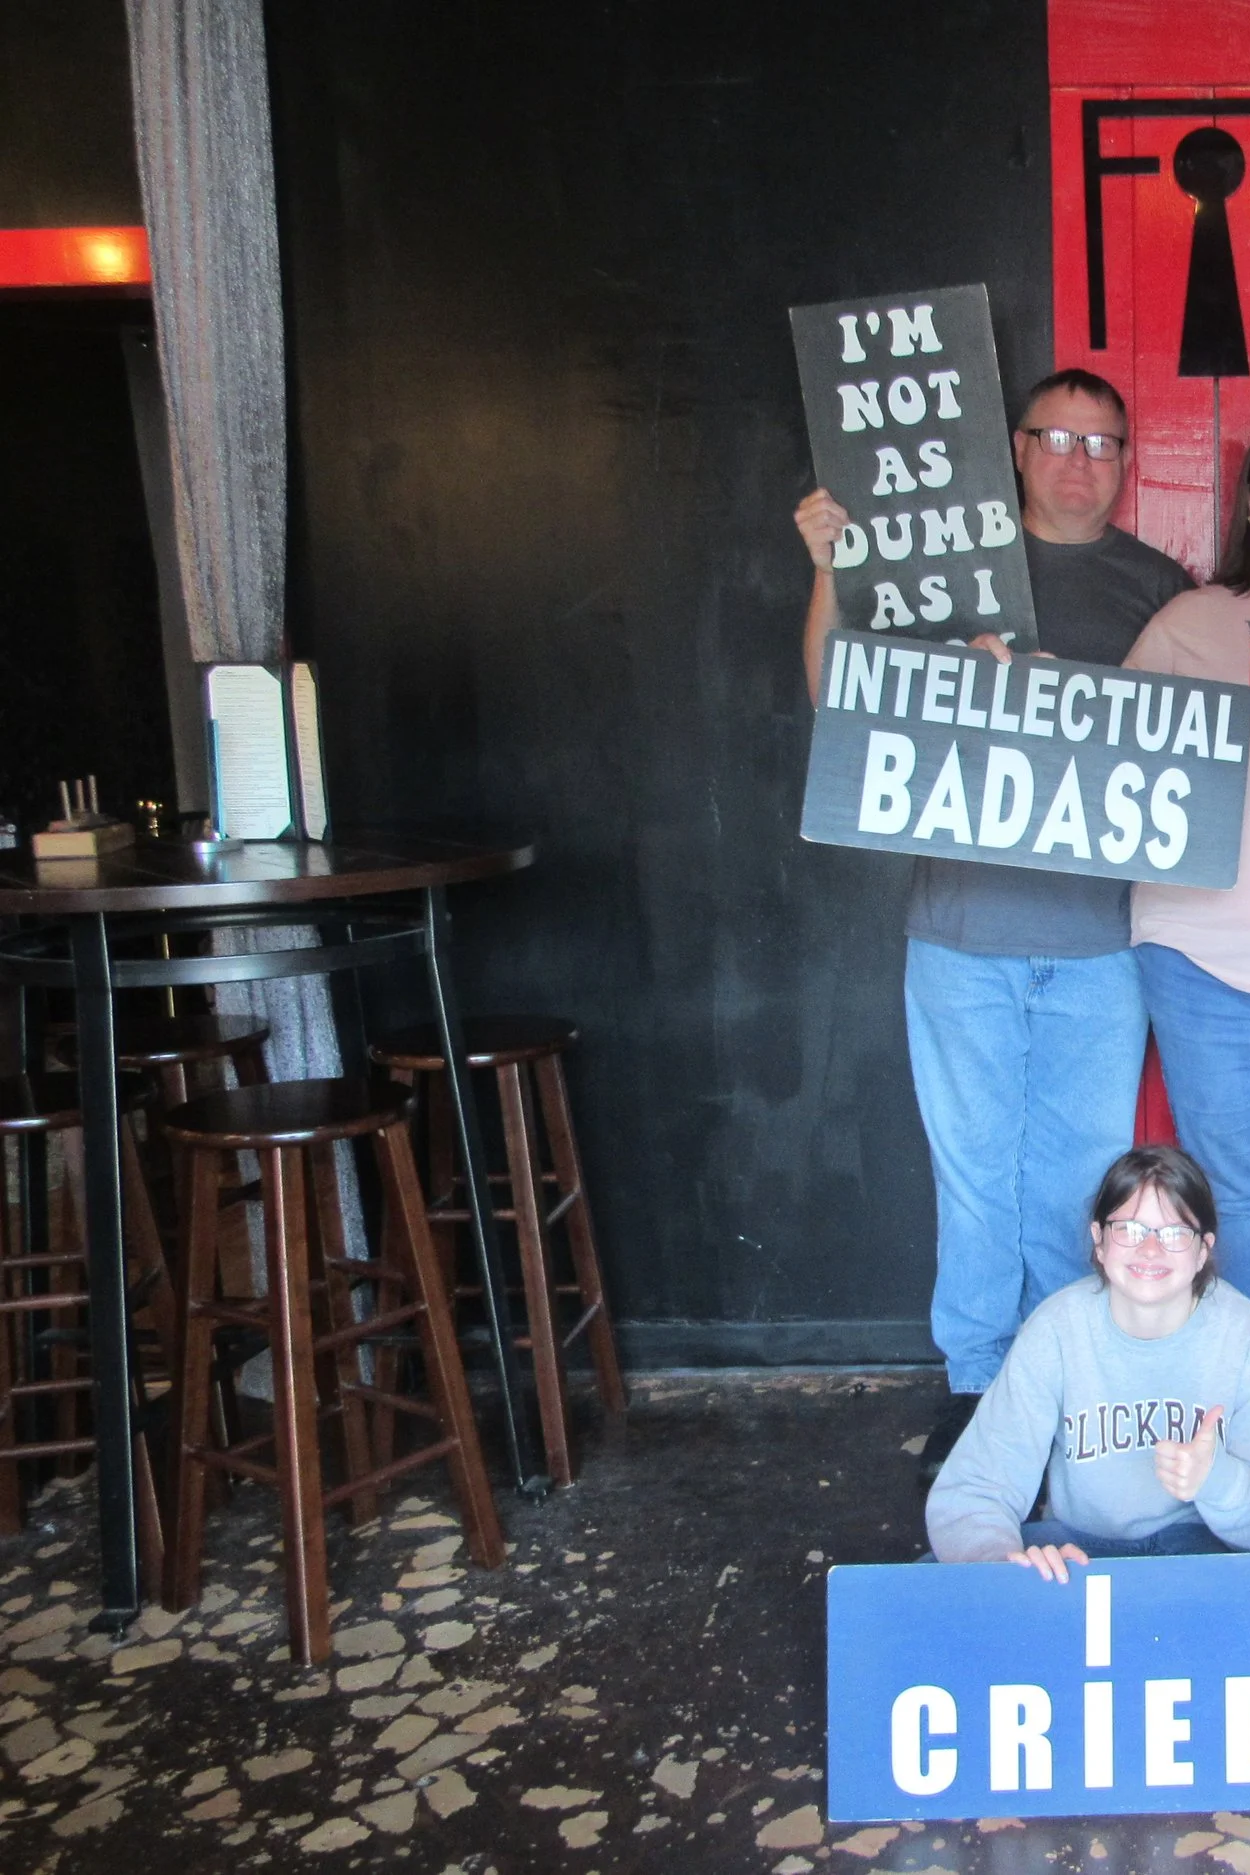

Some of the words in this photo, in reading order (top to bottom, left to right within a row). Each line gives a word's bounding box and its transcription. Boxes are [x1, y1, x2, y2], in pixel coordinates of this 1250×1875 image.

[839, 304, 943, 363] I'M
[837, 370, 961, 432] NOT
[873, 441, 953, 496] AS
[832, 500, 1016, 568] DUMB
[871, 576, 953, 629] AS
[974, 569, 1000, 615] I
[827, 640, 1243, 763] INTELLECTUAL
[856, 730, 1191, 870] BADASS
[1086, 1575, 1111, 1666] I
